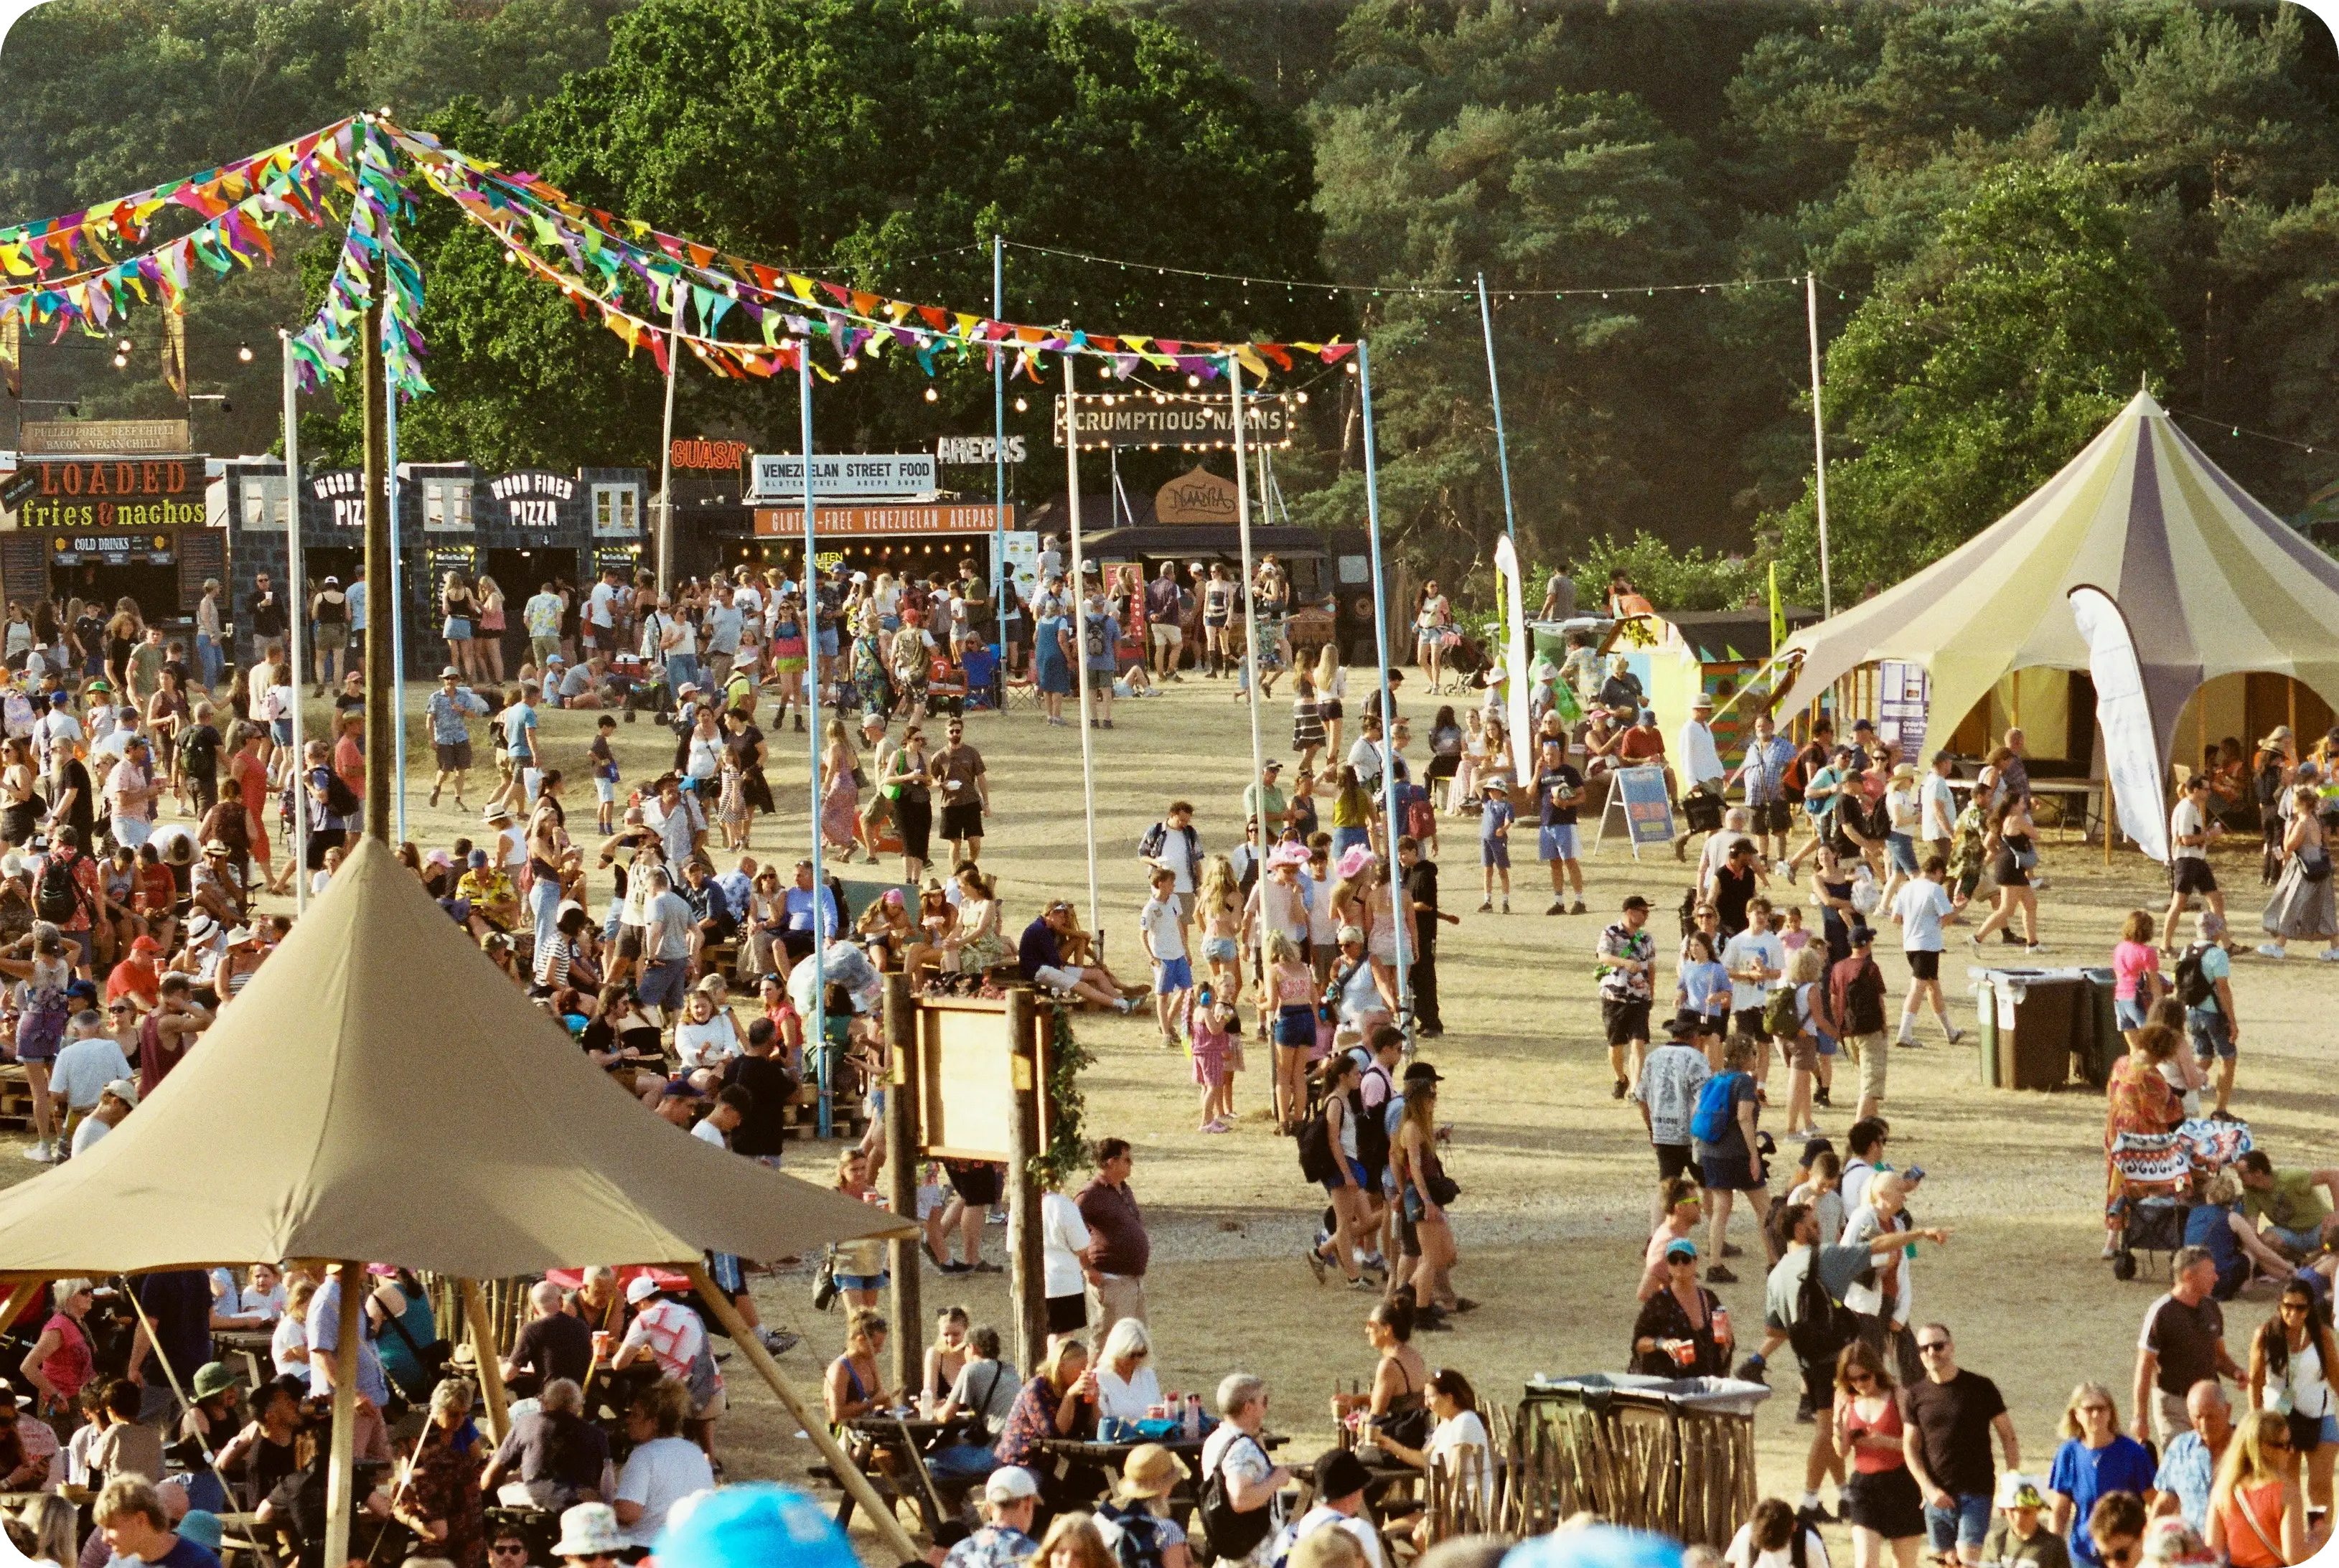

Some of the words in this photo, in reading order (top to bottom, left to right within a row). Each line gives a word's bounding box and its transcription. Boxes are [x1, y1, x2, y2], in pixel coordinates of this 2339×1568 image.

[34, 427, 74, 437] PULLED
[76, 426, 103, 437] PORK
[111, 426, 138, 436] BEEF
[139, 425, 174, 436] CHILLI
[46, 440, 80, 450] BACON
[89, 439, 124, 449] VEGAN
[126, 438, 161, 449] CHILLI
[937, 435, 1027, 464] AREPAS
[41, 461, 186, 495] LOADED
[762, 464, 839, 477] VENEZELAN
[846, 463, 892, 477] STREET
[899, 462, 929, 476] FOOD
[314, 473, 355, 499] WOOD
[491, 474, 530, 500] WOOD
[535, 474, 573, 499] FIRED
[23, 499, 93, 527] fries
[98, 502, 114, 527] &
[118, 499, 206, 525] nachos
[334, 499, 365, 525] PIZ
[510, 501, 558, 526] PIZZA
[772, 510, 853, 532] GLUTE-FREE
[864, 510, 938, 530] VENEZUELAN
[950, 509, 994, 528] AREPAS
[75, 537, 96, 551] COLD
[98, 537, 129, 550] DRINKS
[802, 552, 843, 562] GUTEN
